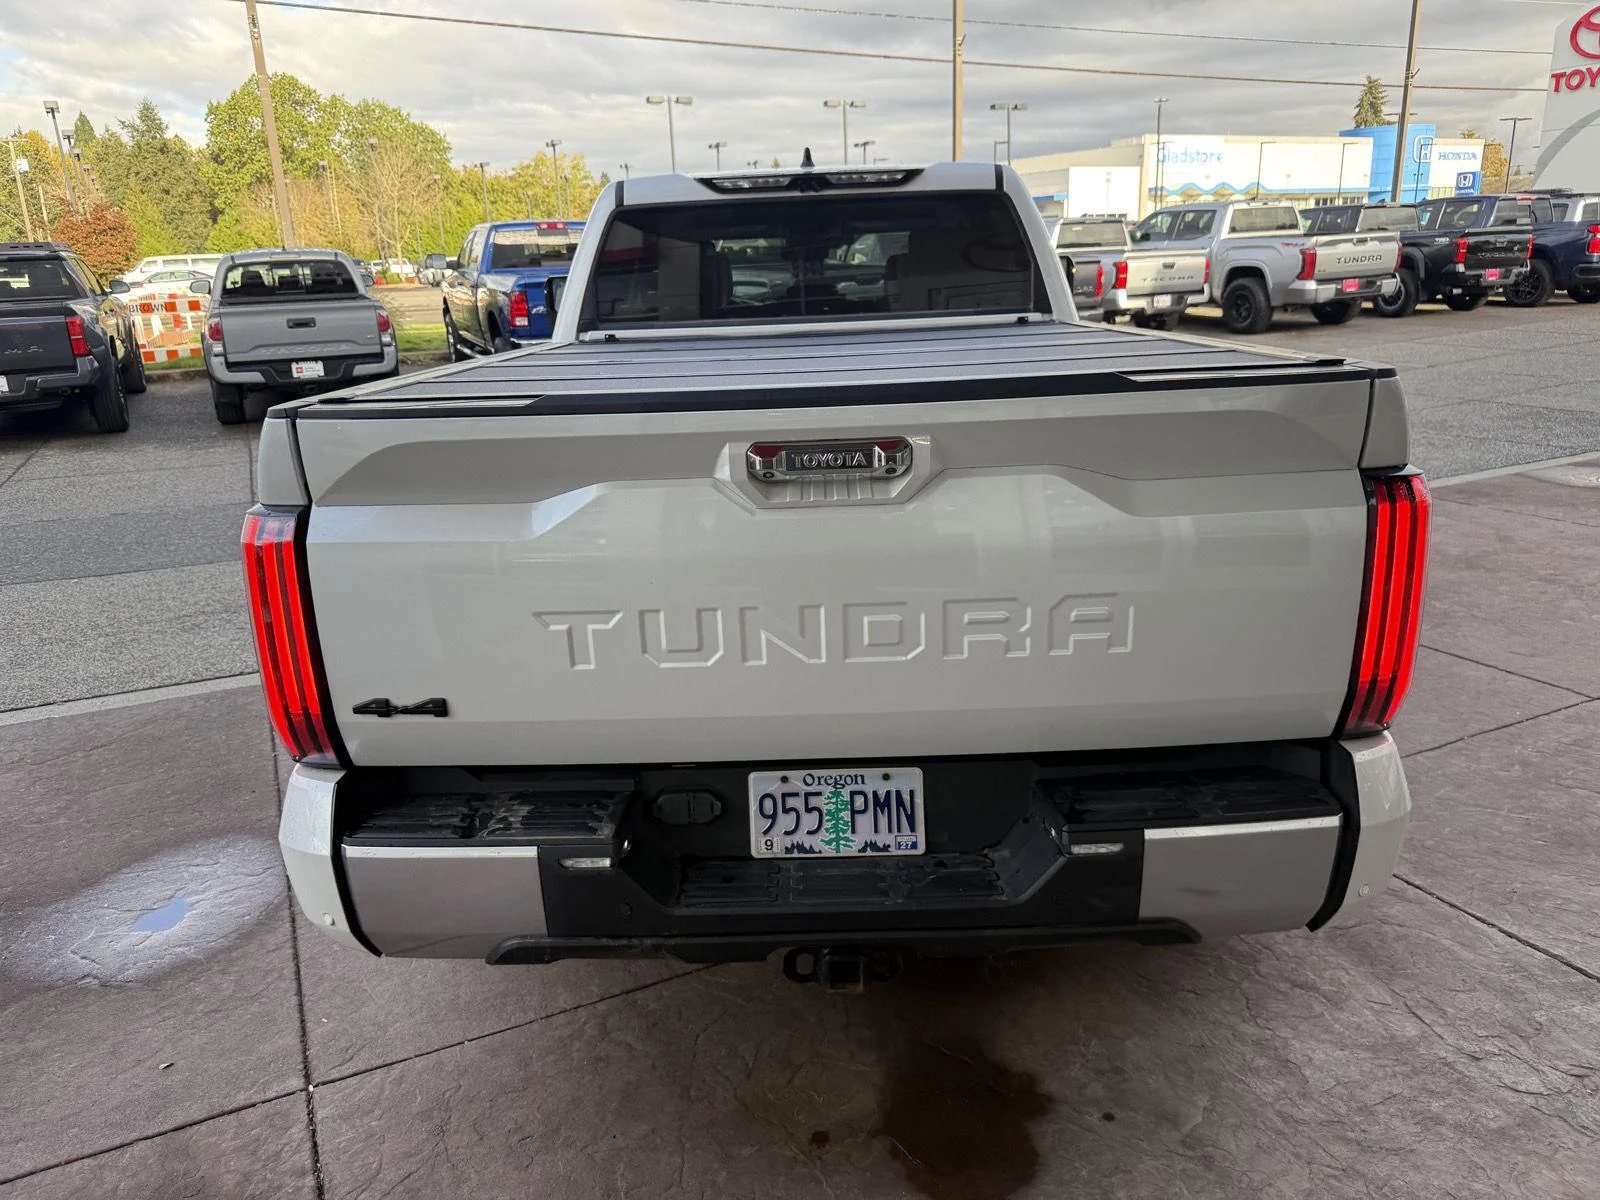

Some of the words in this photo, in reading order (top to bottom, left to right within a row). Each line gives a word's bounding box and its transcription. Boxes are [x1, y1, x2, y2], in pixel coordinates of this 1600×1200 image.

[1437, 151, 1477, 160] HONDA
[1336, 254, 1383, 264] TUNDRA
[128, 303, 168, 313] BROWN
[793, 450, 868, 468] TOYOTA
[532, 592, 1135, 671] TUNDRA
[803, 773, 866, 789] Oregon
[758, 791, 824, 836] 955
[850, 789, 916, 835] PMN
[764, 838, 774, 851] 9
[900, 841, 912, 849] 27
